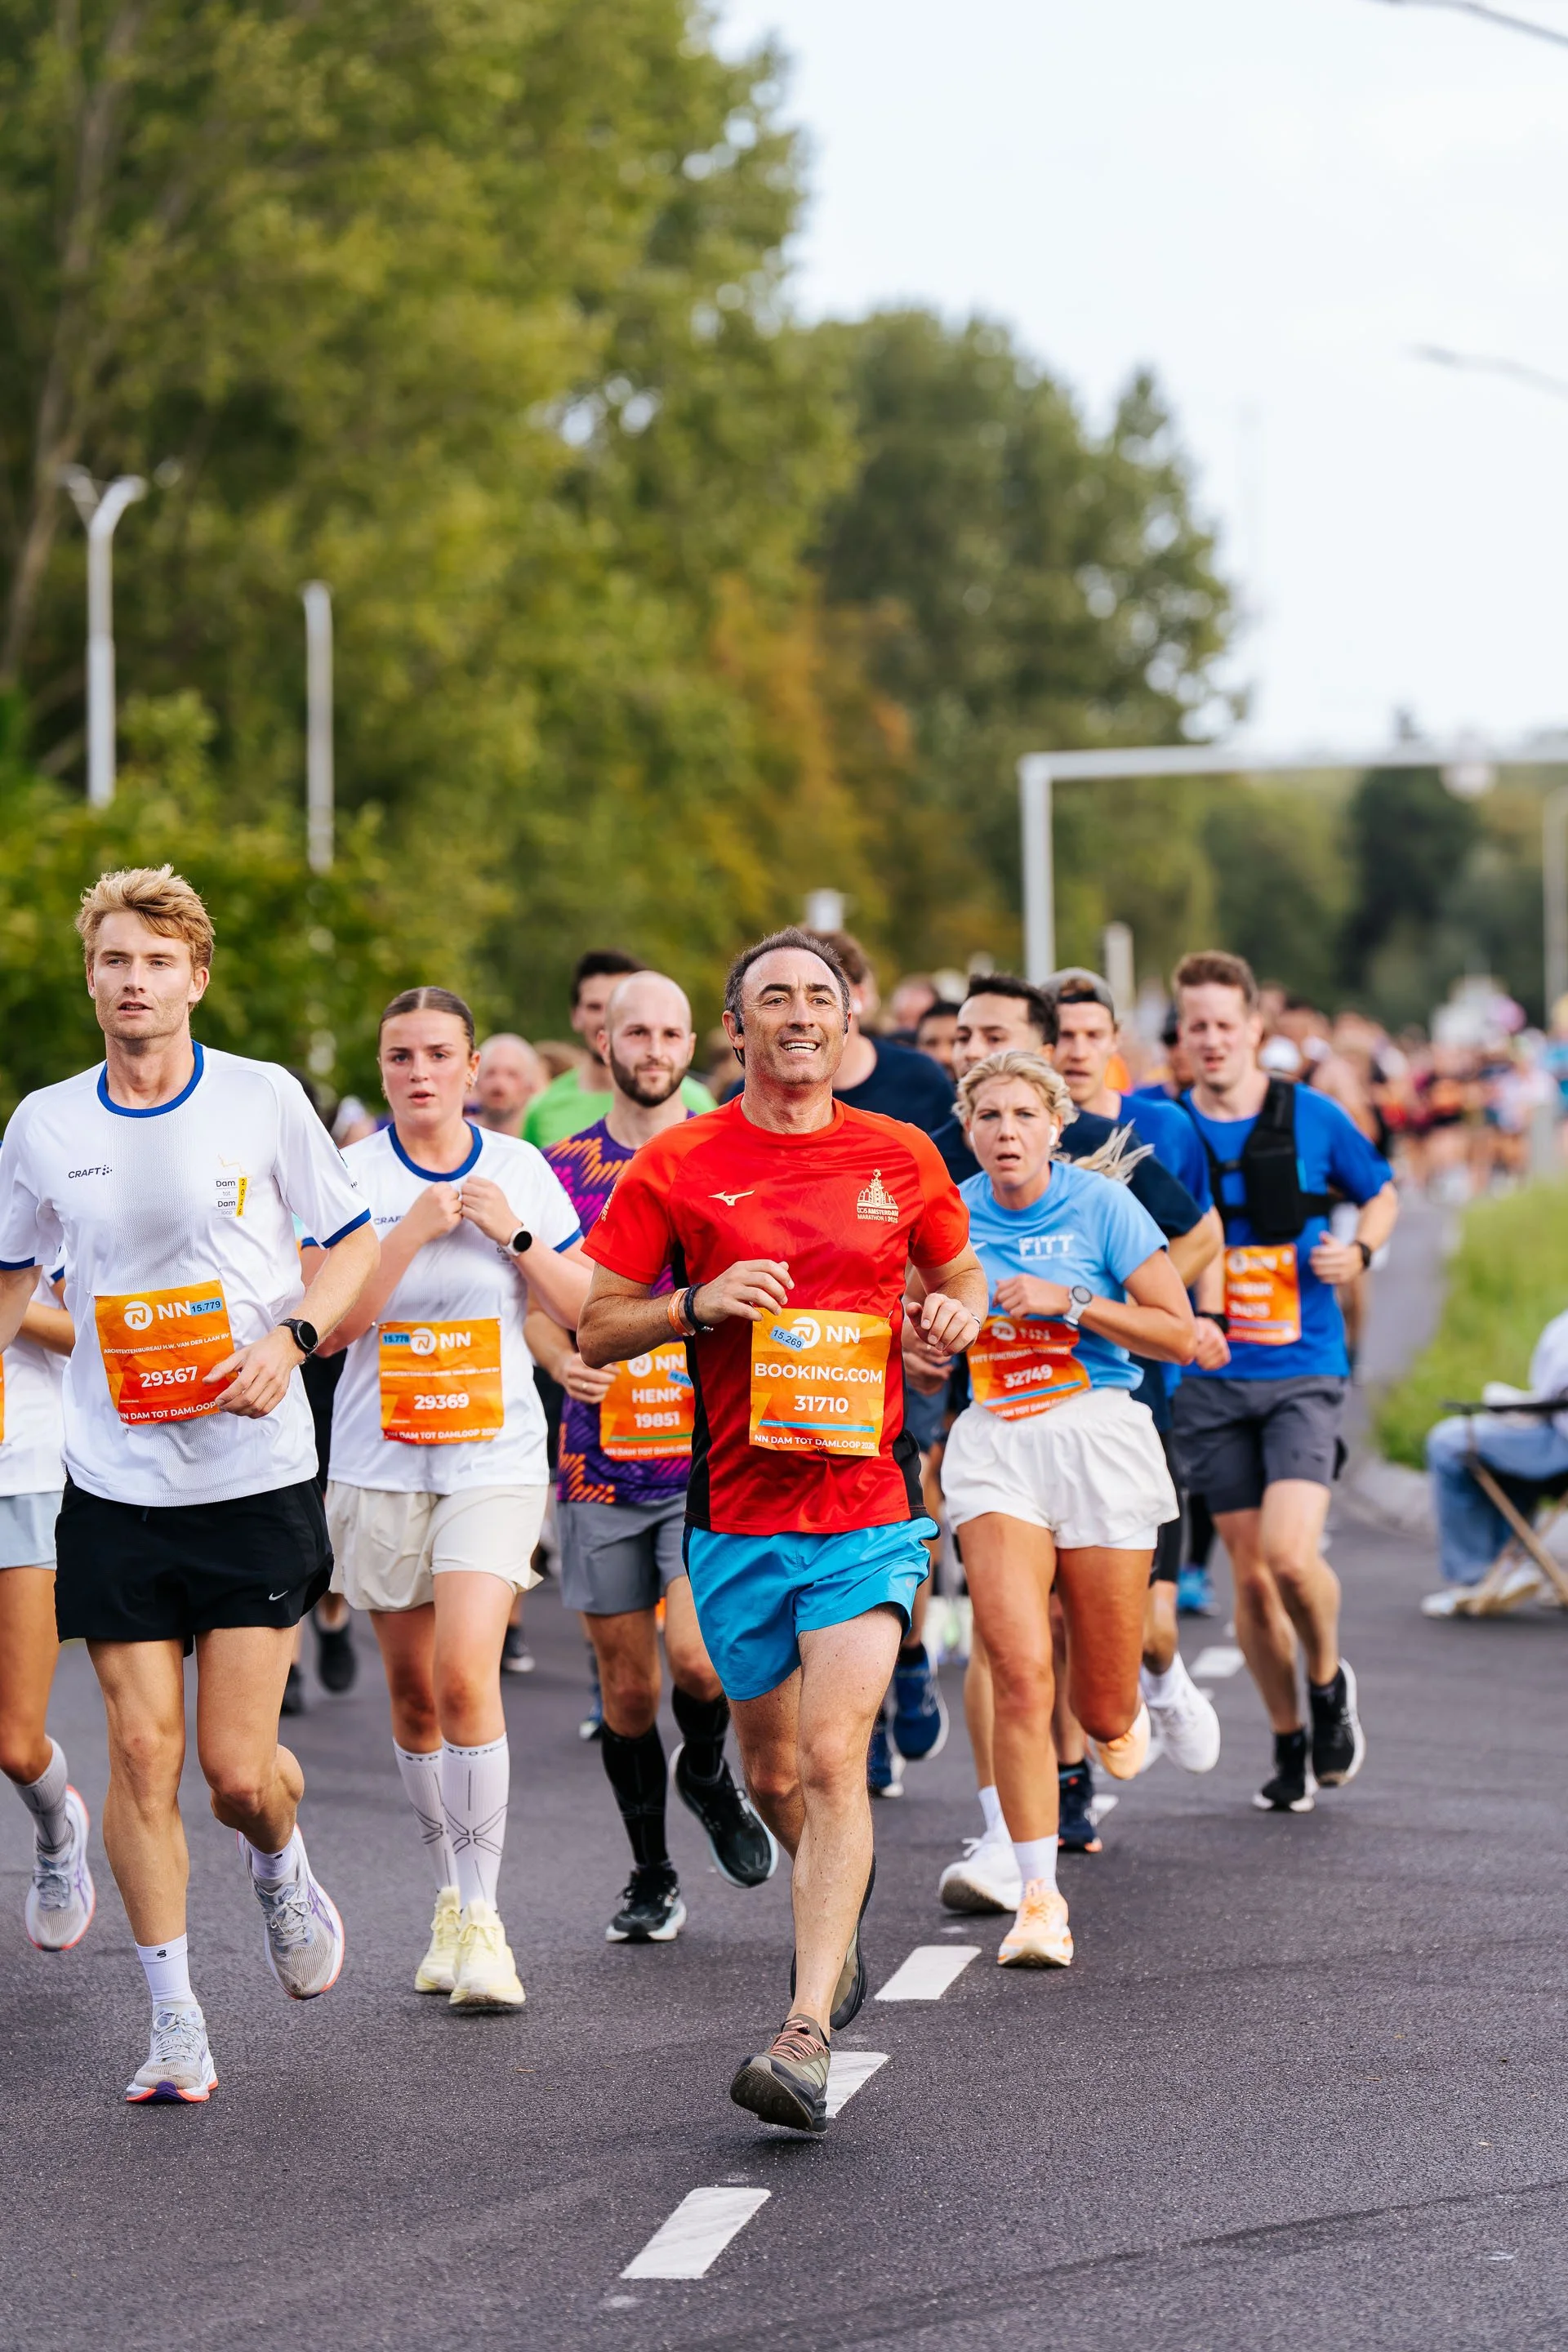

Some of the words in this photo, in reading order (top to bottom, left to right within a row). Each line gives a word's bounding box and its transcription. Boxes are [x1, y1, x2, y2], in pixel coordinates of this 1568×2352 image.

[68, 1167, 101, 1178] CRAFT
[373, 1215, 406, 1225] CRAF
[867, 1208, 899, 1217] AMSTERDAM
[1018, 1234, 1075, 1256] FITT
[156, 1300, 191, 1321] NN
[191, 1300, 221, 1313] 15.779
[439, 1331, 471, 1349] NN
[773, 1329, 802, 1348] 15.269
[826, 1325, 861, 1343] NN
[104, 1345, 163, 1354] ARCHITEKTENBUREAU
[204, 1335, 220, 1343] LAAN
[655, 1354, 685, 1371] NN
[139, 1365, 198, 1388] 29367
[755, 1362, 883, 1384] BOOKING.COM
[1003, 1364, 1054, 1388] 32749
[413, 1393, 470, 1410] 29369
[631, 1386, 683, 1404] HENK
[794, 1394, 849, 1414] 31710
[130, 1410, 150, 1420] DAM
[151, 1409, 169, 1419] TOT
[170, 1401, 216, 1417] DAMLOOP
[421, 1431, 437, 1440] TOT
[437, 1428, 480, 1440] DAMLOOP
[754, 1434, 768, 1443] NN
[770, 1436, 792, 1445] DAM
[794, 1437, 813, 1445] TOT
[815, 1439, 862, 1449] DAMLOOP
